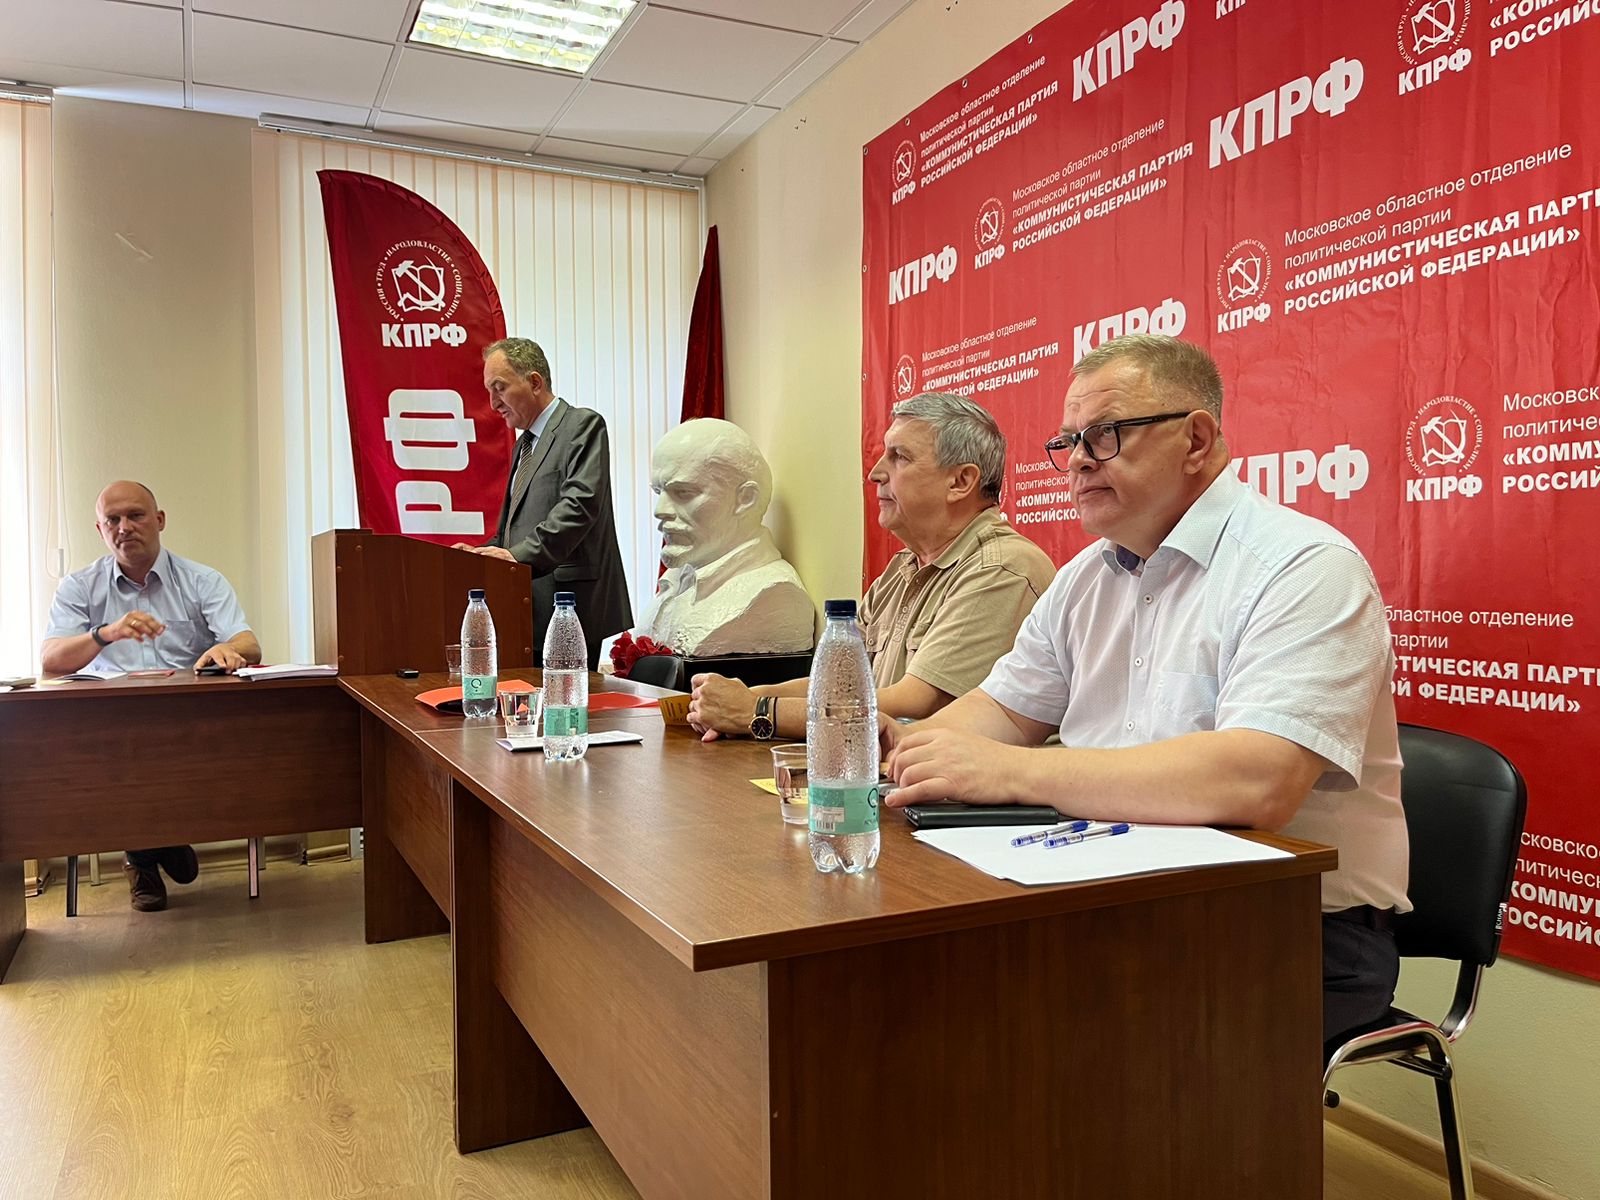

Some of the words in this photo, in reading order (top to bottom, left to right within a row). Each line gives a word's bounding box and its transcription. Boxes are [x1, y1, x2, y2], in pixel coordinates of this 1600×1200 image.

[1073, 0, 1186, 103] КПРФ
[1398, 47, 1472, 96] КПРФ
[919, 111, 959, 143] Московское
[960, 85, 1000, 117] областное
[1001, 55, 1046, 91] отделение
[1208, 56, 1365, 170] КПРФ
[920, 107, 1015, 173] «КОММУНИСТИЧЕСКАЯ
[1017, 80, 1059, 114] ПАРТИЯ
[920, 121, 967, 158] политической
[968, 105, 994, 130] партии
[920, 145, 974, 188] РОССИЙСКОЙ
[975, 113, 1038, 155] ФЕДЕРАЦИИ»
[1012, 170, 1060, 203] Московское
[1061, 146, 1109, 178] областное
[1111, 117, 1165, 154] отделение
[892, 181, 916, 205] КПРФ
[1012, 169, 1136, 235] «КОММУНИСТИЧЕСКАЯ
[1138, 142, 1194, 178] ПАРТИЯ
[1012, 184, 1068, 219] политической
[1069, 168, 1102, 194] партии
[1284, 206, 1372, 247] Московское
[1375, 177, 1466, 218] областное
[1469, 141, 1573, 189] отделение
[1012, 210, 1081, 253] РОССИЙСКОЙ
[1083, 177, 1168, 221] ФЕДЕРАЦИИ»
[1284, 225, 1387, 270] политической
[1391, 207, 1452, 242] партии
[974, 244, 1006, 270] КПРФ
[1284, 209, 1520, 293] «КОММУНИСТИЧЕСКАЯ
[1527, 187, 1600, 225] ПАРТ
[887, 244, 959, 306] КПРФ
[1284, 264, 1415, 316] РОССИЙСКОЙ
[1420, 226, 1580, 281] ФЕДЕРАЦИИ»
[380, 322, 468, 347] КПРФ
[921, 343, 960, 363] Московское
[960, 330, 995, 351] областное
[996, 316, 1037, 339] отделение
[1217, 302, 1271, 334] КПРФ
[921, 355, 965, 378] политической
[965, 349, 991, 368] партии
[921, 355, 1016, 393] «КОММУНИСТИЧЕСКАЯ
[1018, 342, 1059, 364] ПАРТИЯ
[976, 366, 1039, 393] ФЕДЕРАЦИИ»
[1503, 386, 1600, 412] Московск
[1503, 415, 1600, 440] политиче
[1406, 474, 1483, 502] КПРФ
[1015, 508, 1081, 525] РОССИЙСКО
[1468, 610, 1574, 628] отделение
[1418, 682, 1581, 713] ФЕДЕРАЦИИ»
[1527, 663, 1600, 687] ПАРТ
[1520, 831, 1600, 859] сковско
[1514, 858, 1600, 889] литичес
